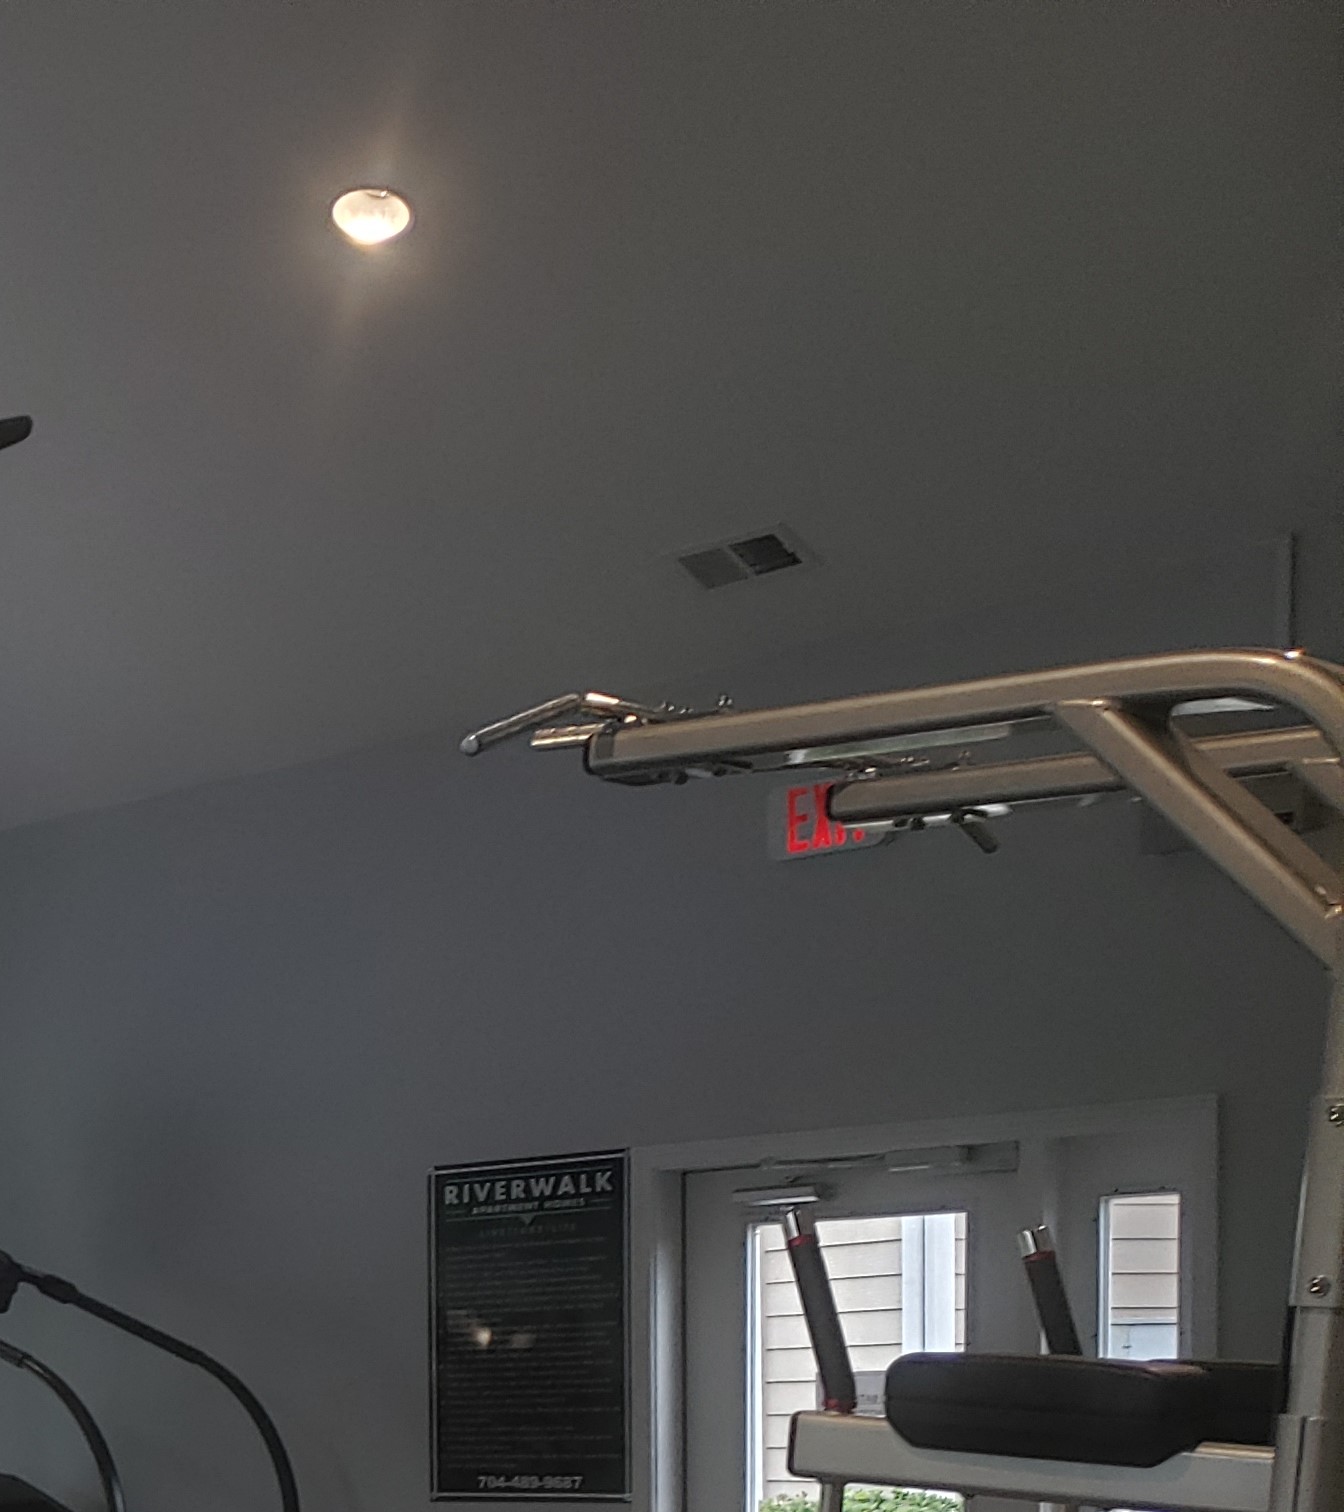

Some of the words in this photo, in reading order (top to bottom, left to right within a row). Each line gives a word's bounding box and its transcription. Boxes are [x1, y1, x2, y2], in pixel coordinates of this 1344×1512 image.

[786, 782, 867, 854] EX
[444, 1171, 613, 1205] RIVERWALK
[472, 1202, 539, 1215] APARTMENT
